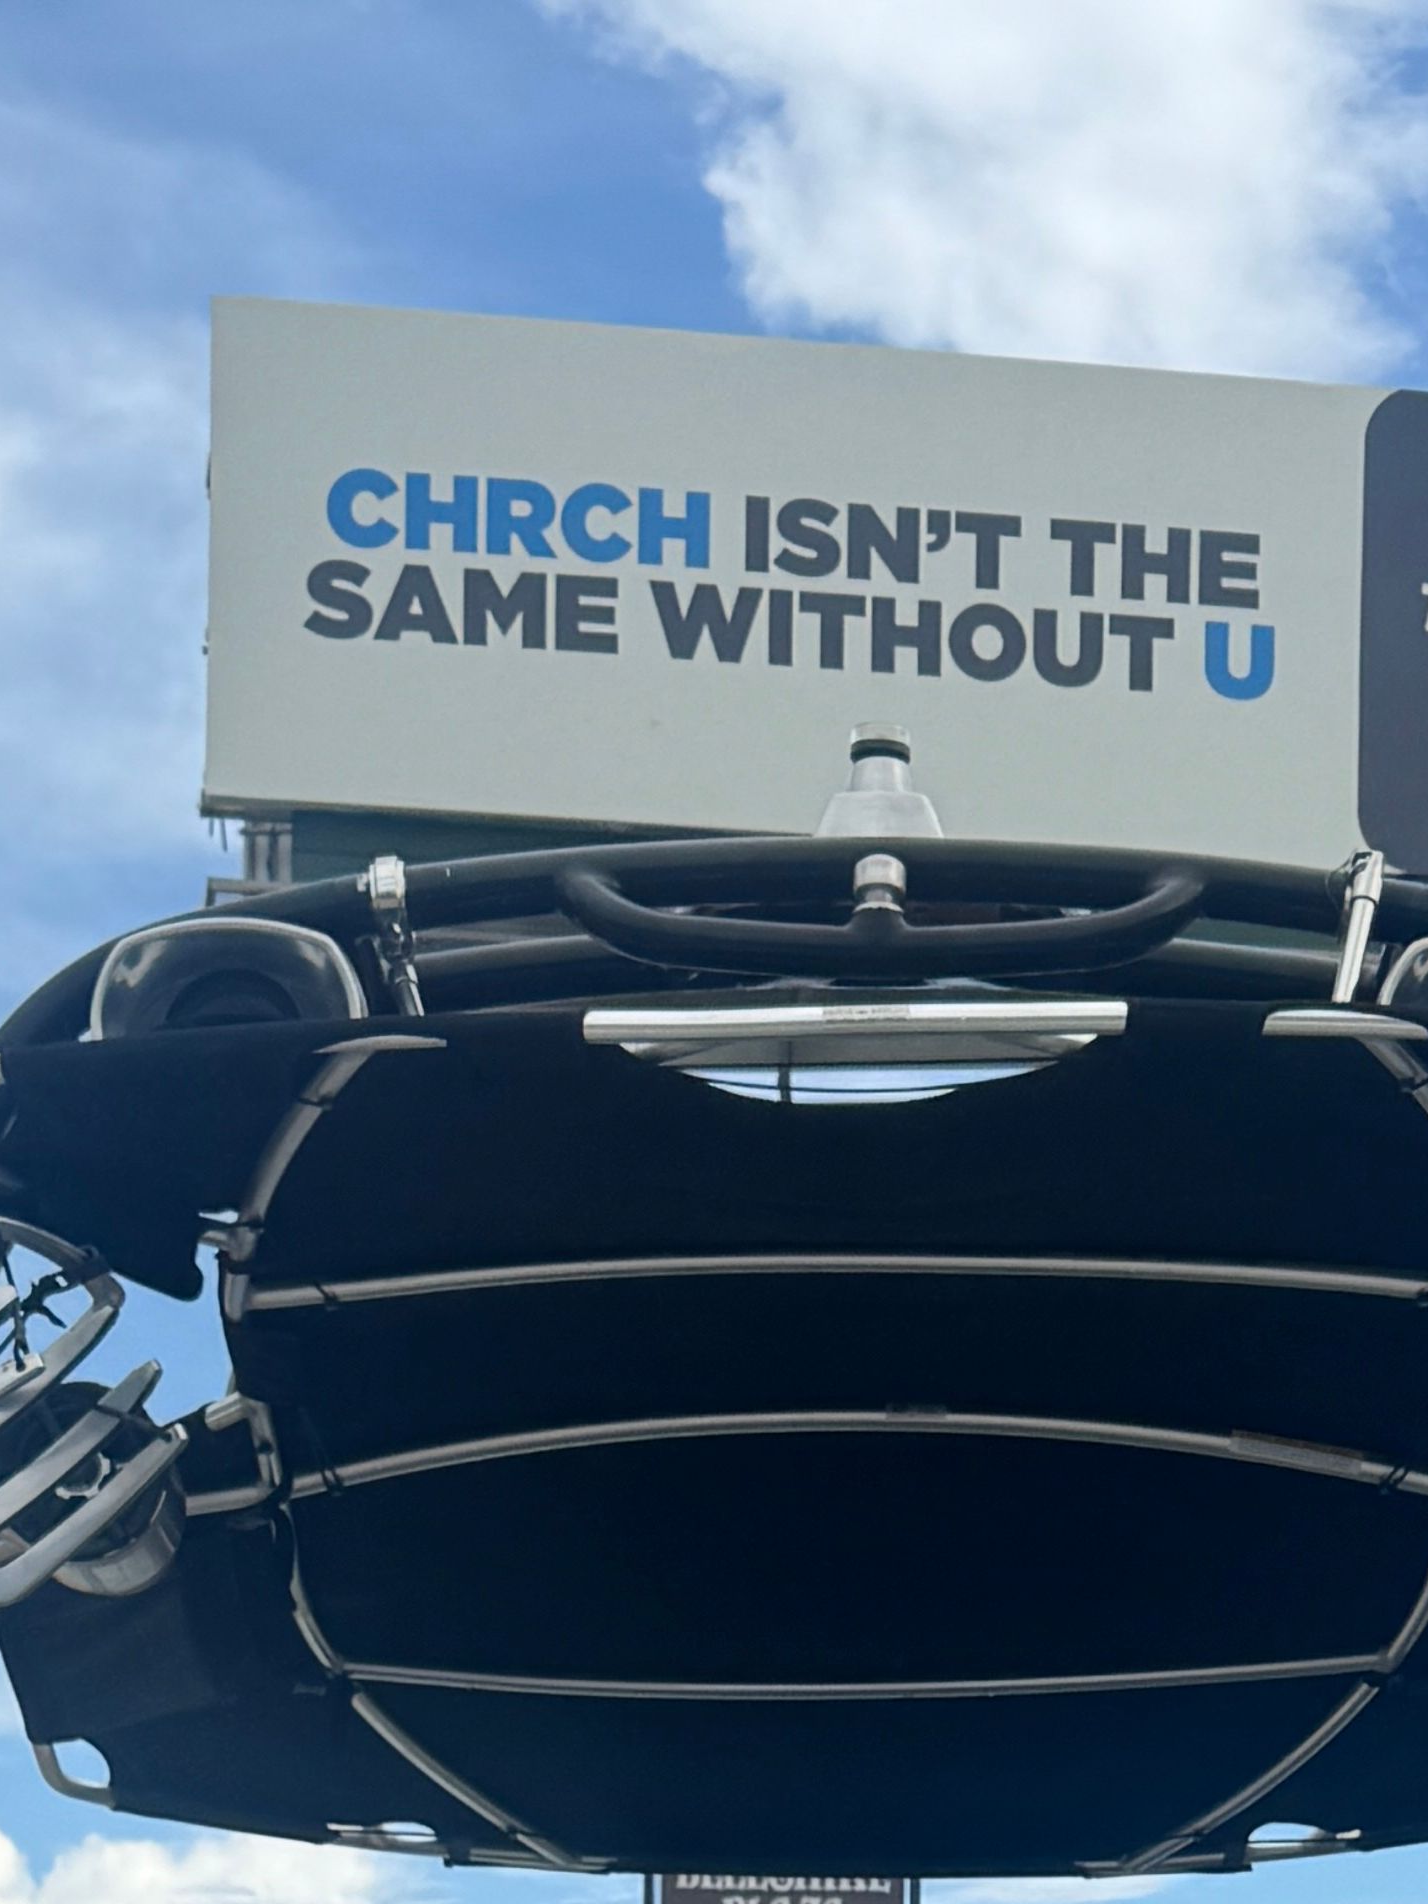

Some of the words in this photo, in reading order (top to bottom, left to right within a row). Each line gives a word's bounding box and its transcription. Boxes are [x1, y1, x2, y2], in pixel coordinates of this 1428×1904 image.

[326, 467, 711, 570] CHRCH
[744, 494, 1022, 591] ISN'T
[1049, 517, 1261, 611] THE
[302, 559, 619, 655] SAME
[648, 579, 1175, 693] WITHOUT
[1203, 620, 1276, 702] U
